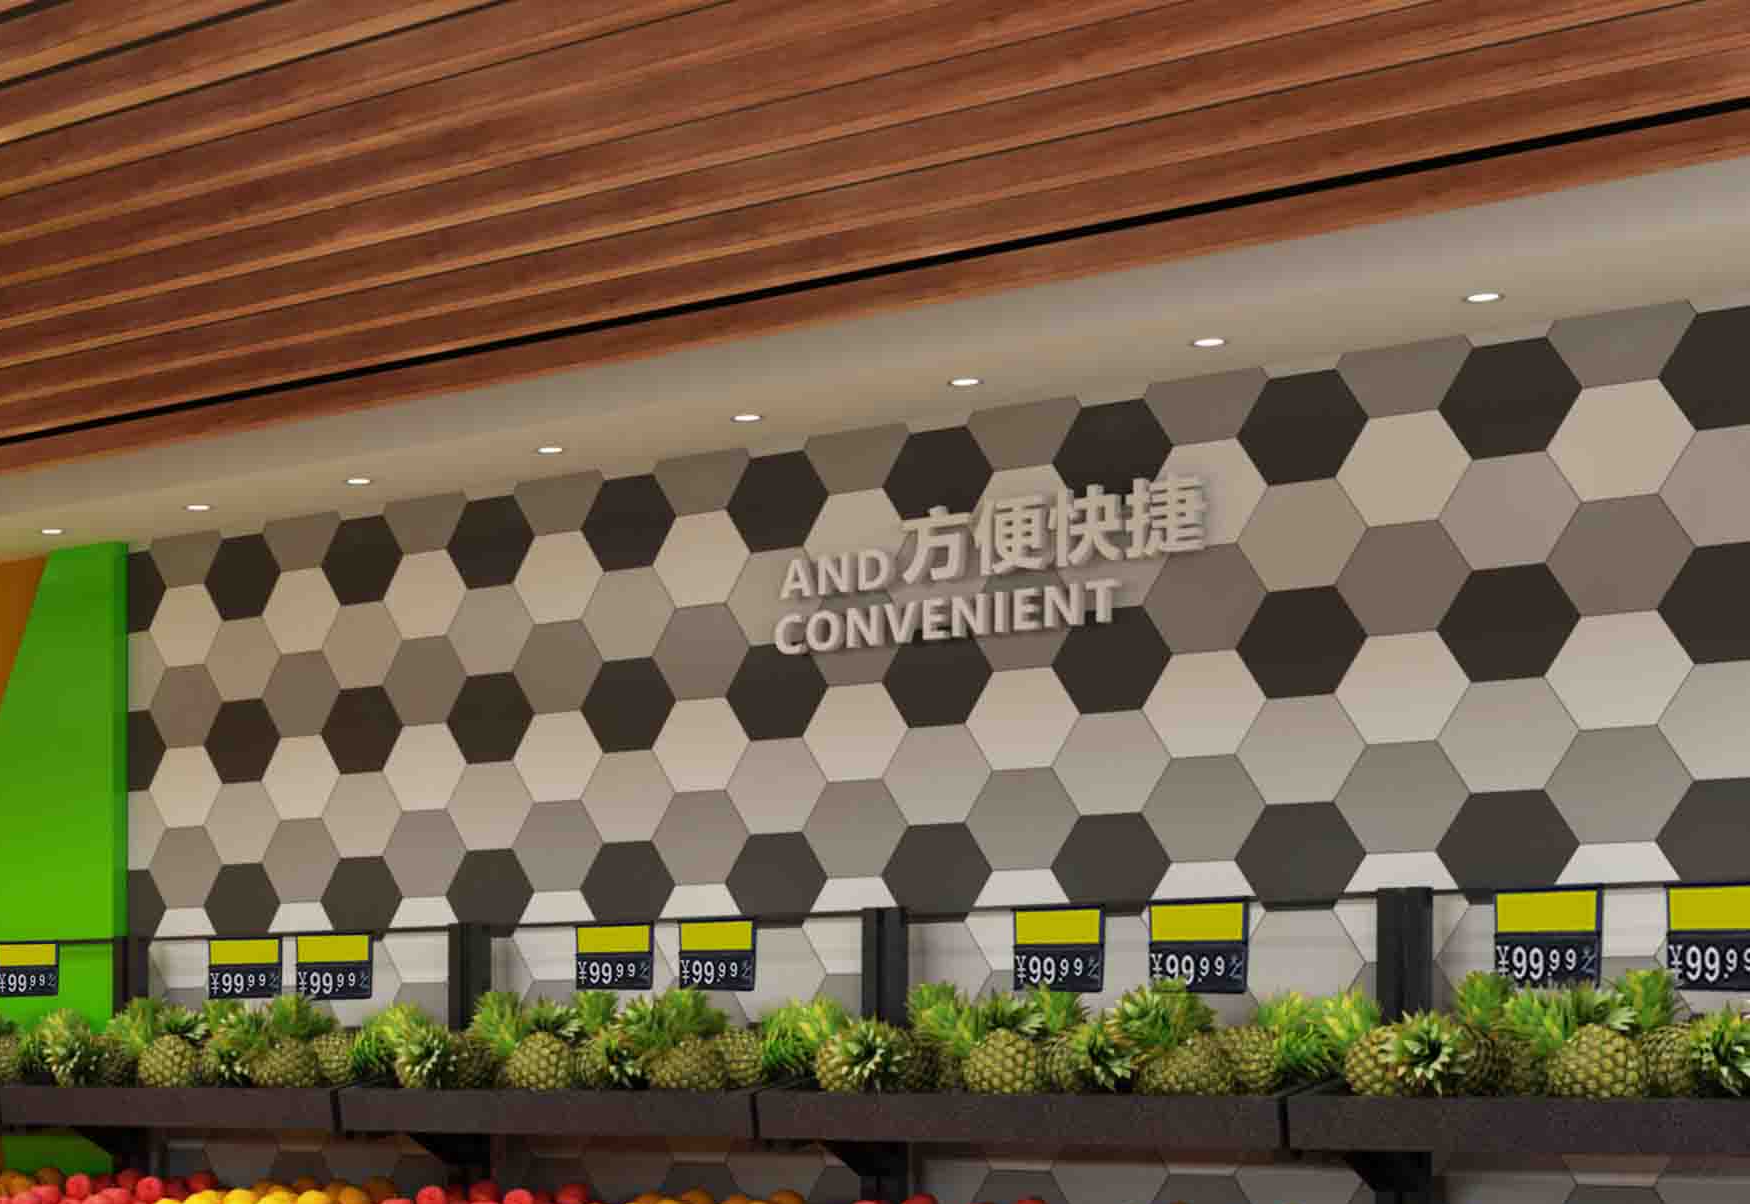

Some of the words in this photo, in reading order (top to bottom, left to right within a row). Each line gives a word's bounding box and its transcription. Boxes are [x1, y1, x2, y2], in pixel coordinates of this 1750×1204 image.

[779, 548, 892, 600] AND
[901, 473, 1208, 585] 方便快捷
[773, 577, 1122, 656] CONVENIENT
[577, 960, 636, 985] ¥99.99
[680, 959, 738, 985] ¥99.99
[1015, 954, 1083, 984] ¥99.99
[1150, 953, 1226, 985] ¥99.99
[1496, 945, 1577, 981] ¥99.99
[210, 972, 267, 995] ¥99.99
[296, 971, 357, 995] ¥99.99
